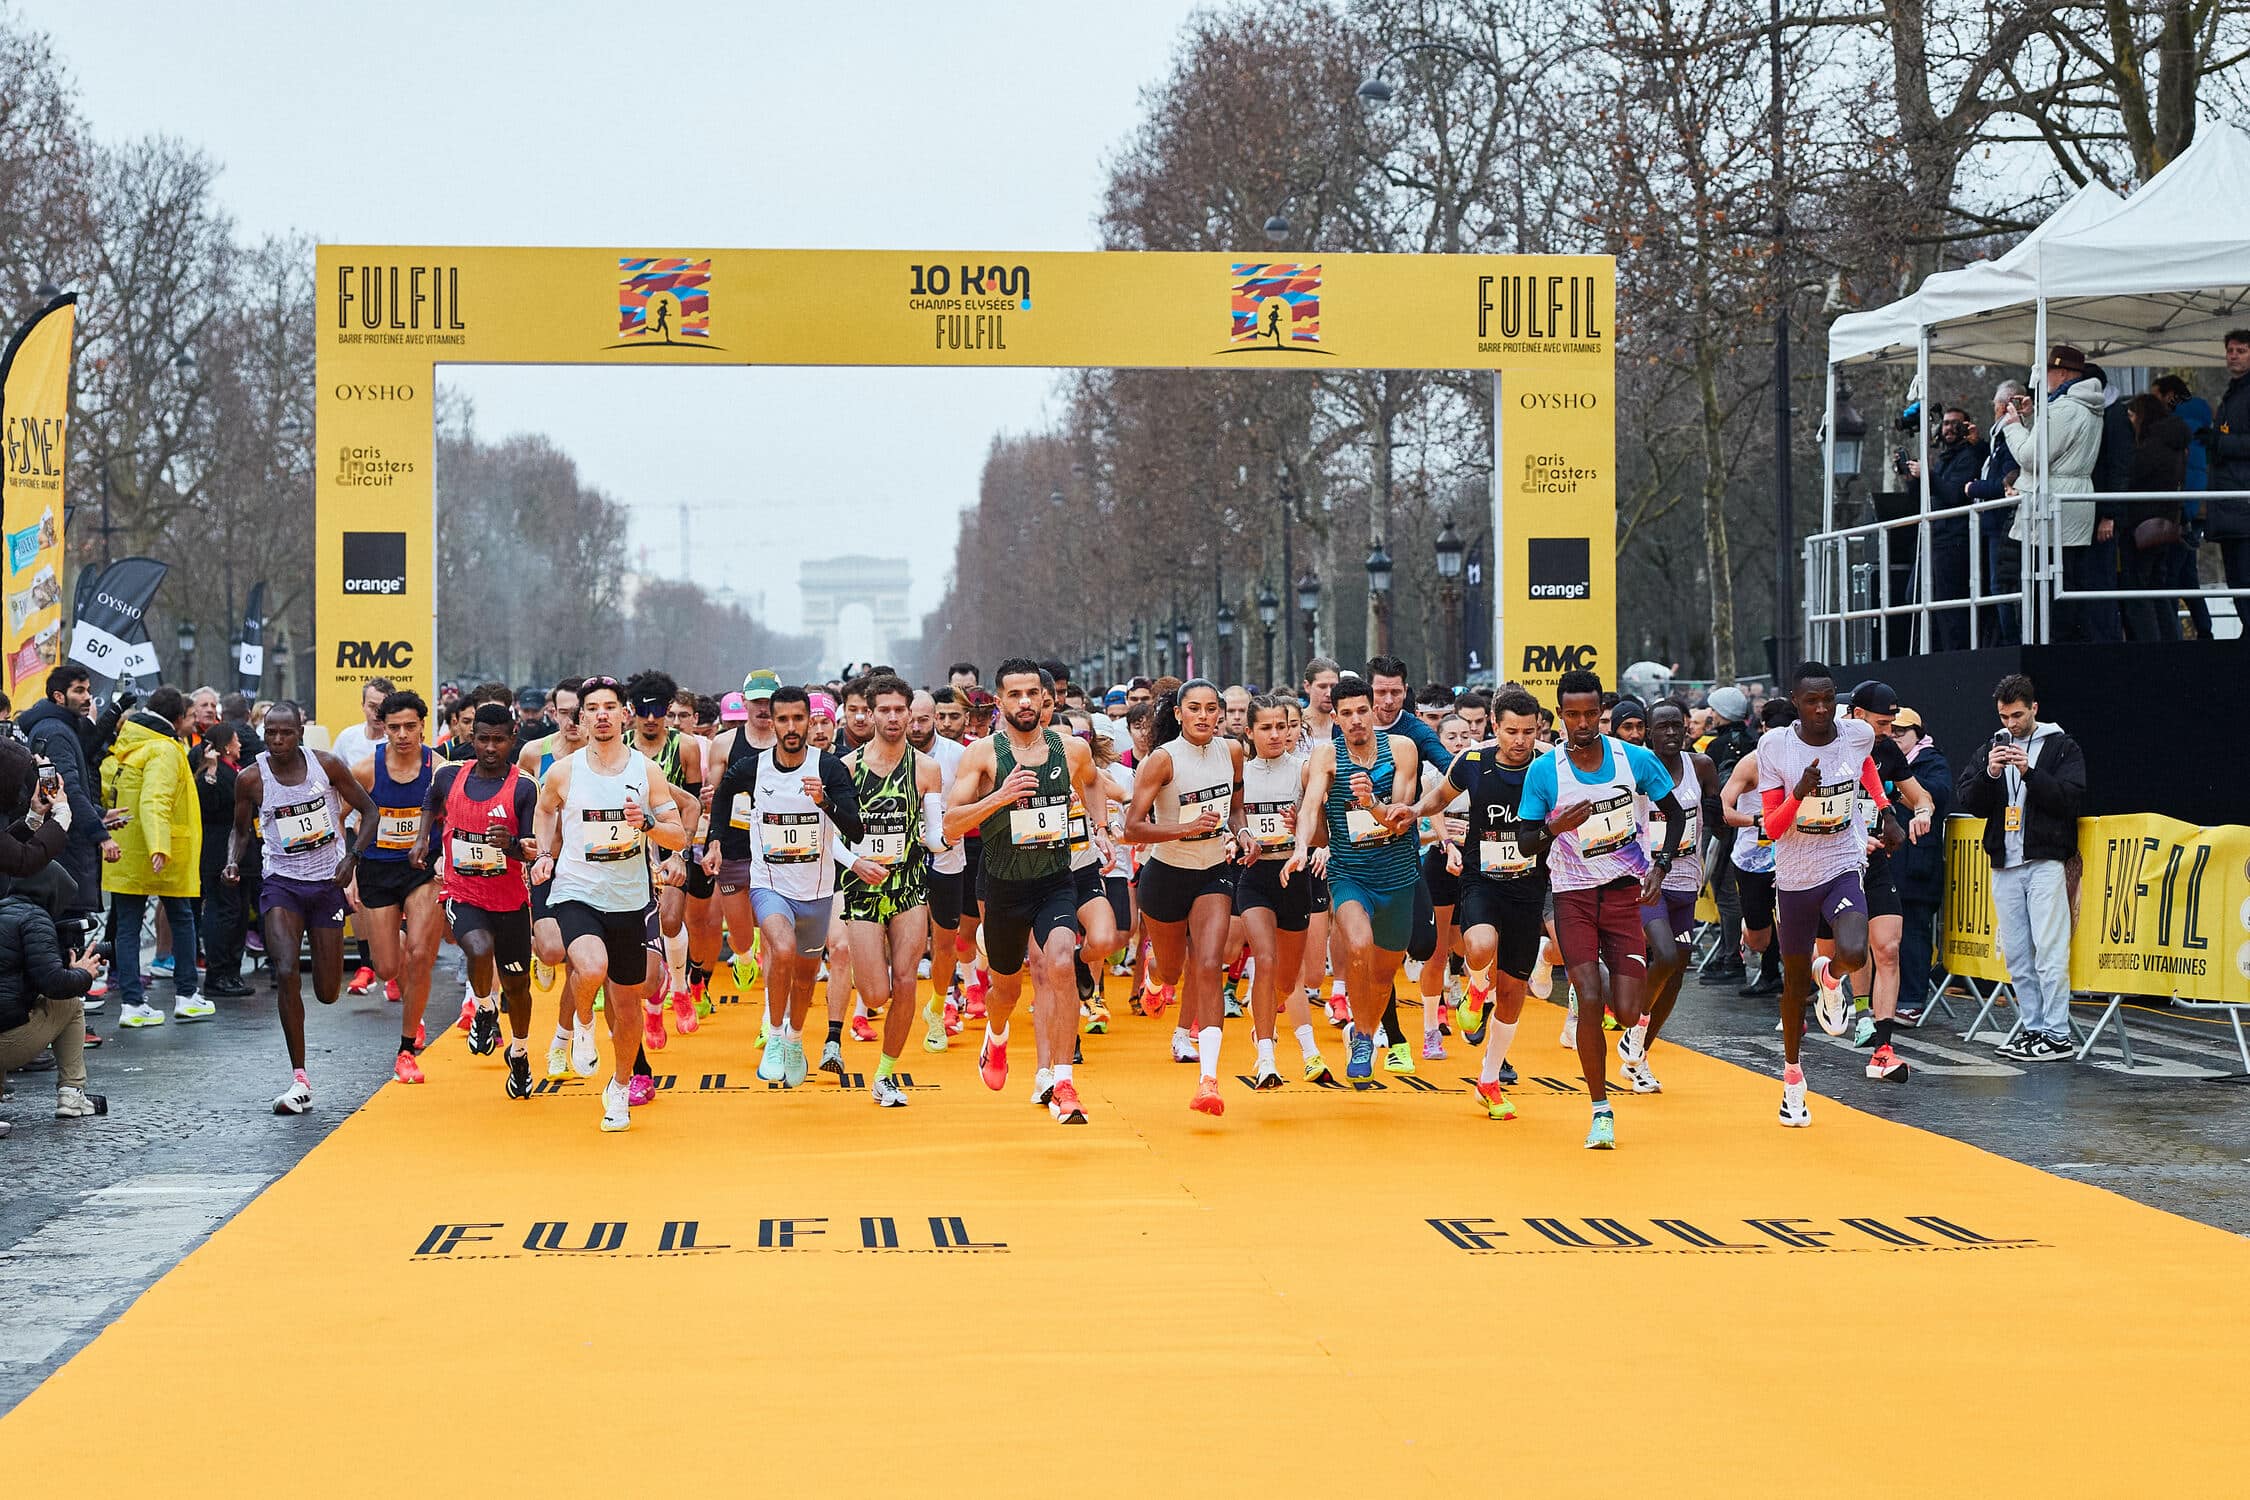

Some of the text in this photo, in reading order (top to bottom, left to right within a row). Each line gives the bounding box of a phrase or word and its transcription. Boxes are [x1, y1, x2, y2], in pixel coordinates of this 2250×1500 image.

[911, 265, 1031, 301] 10 KM
[339, 266, 465, 329] FULFIL
[909, 299, 961, 310] CHAMPS
[1479, 276, 1601, 338] FULFIL
[338, 334, 362, 344] BARRE
[405, 334, 424, 344] AVEC
[425, 334, 465, 345] VITAMINES
[936, 315, 1006, 349] FULFIL
[1478, 343, 1502, 353] BARRE
[1543, 343, 1561, 353] AVEC
[1562, 343, 1601, 353] VITAMINES
[336, 384, 413, 401] OYSHO
[1520, 393, 1597, 409] OYSHO
[97, 592, 141, 619] OYSHO
[87, 638, 113, 658] 60'
[336, 641, 413, 669] RMC
[1522, 645, 1597, 672] RMC
[1821, 801, 1833, 815] 14
[299, 816, 312, 832] 13
[395, 821, 414, 832] 168
[1038, 812, 1046, 828] 8
[1260, 817, 1275, 833] 55
[1604, 816, 1611, 832] 1
[610, 825, 618, 841] 2
[783, 829, 797, 844] 10
[470, 846, 483, 860] 15
[871, 838, 884, 853] 19
[1501, 845, 1515, 860] 12
[2100, 837, 2211, 950] FULFIL
[2143, 954, 2207, 976] VITAMINES
[415, 1217, 1007, 1255] FULFIL
[1425, 1216, 2039, 1249] FULFIL
